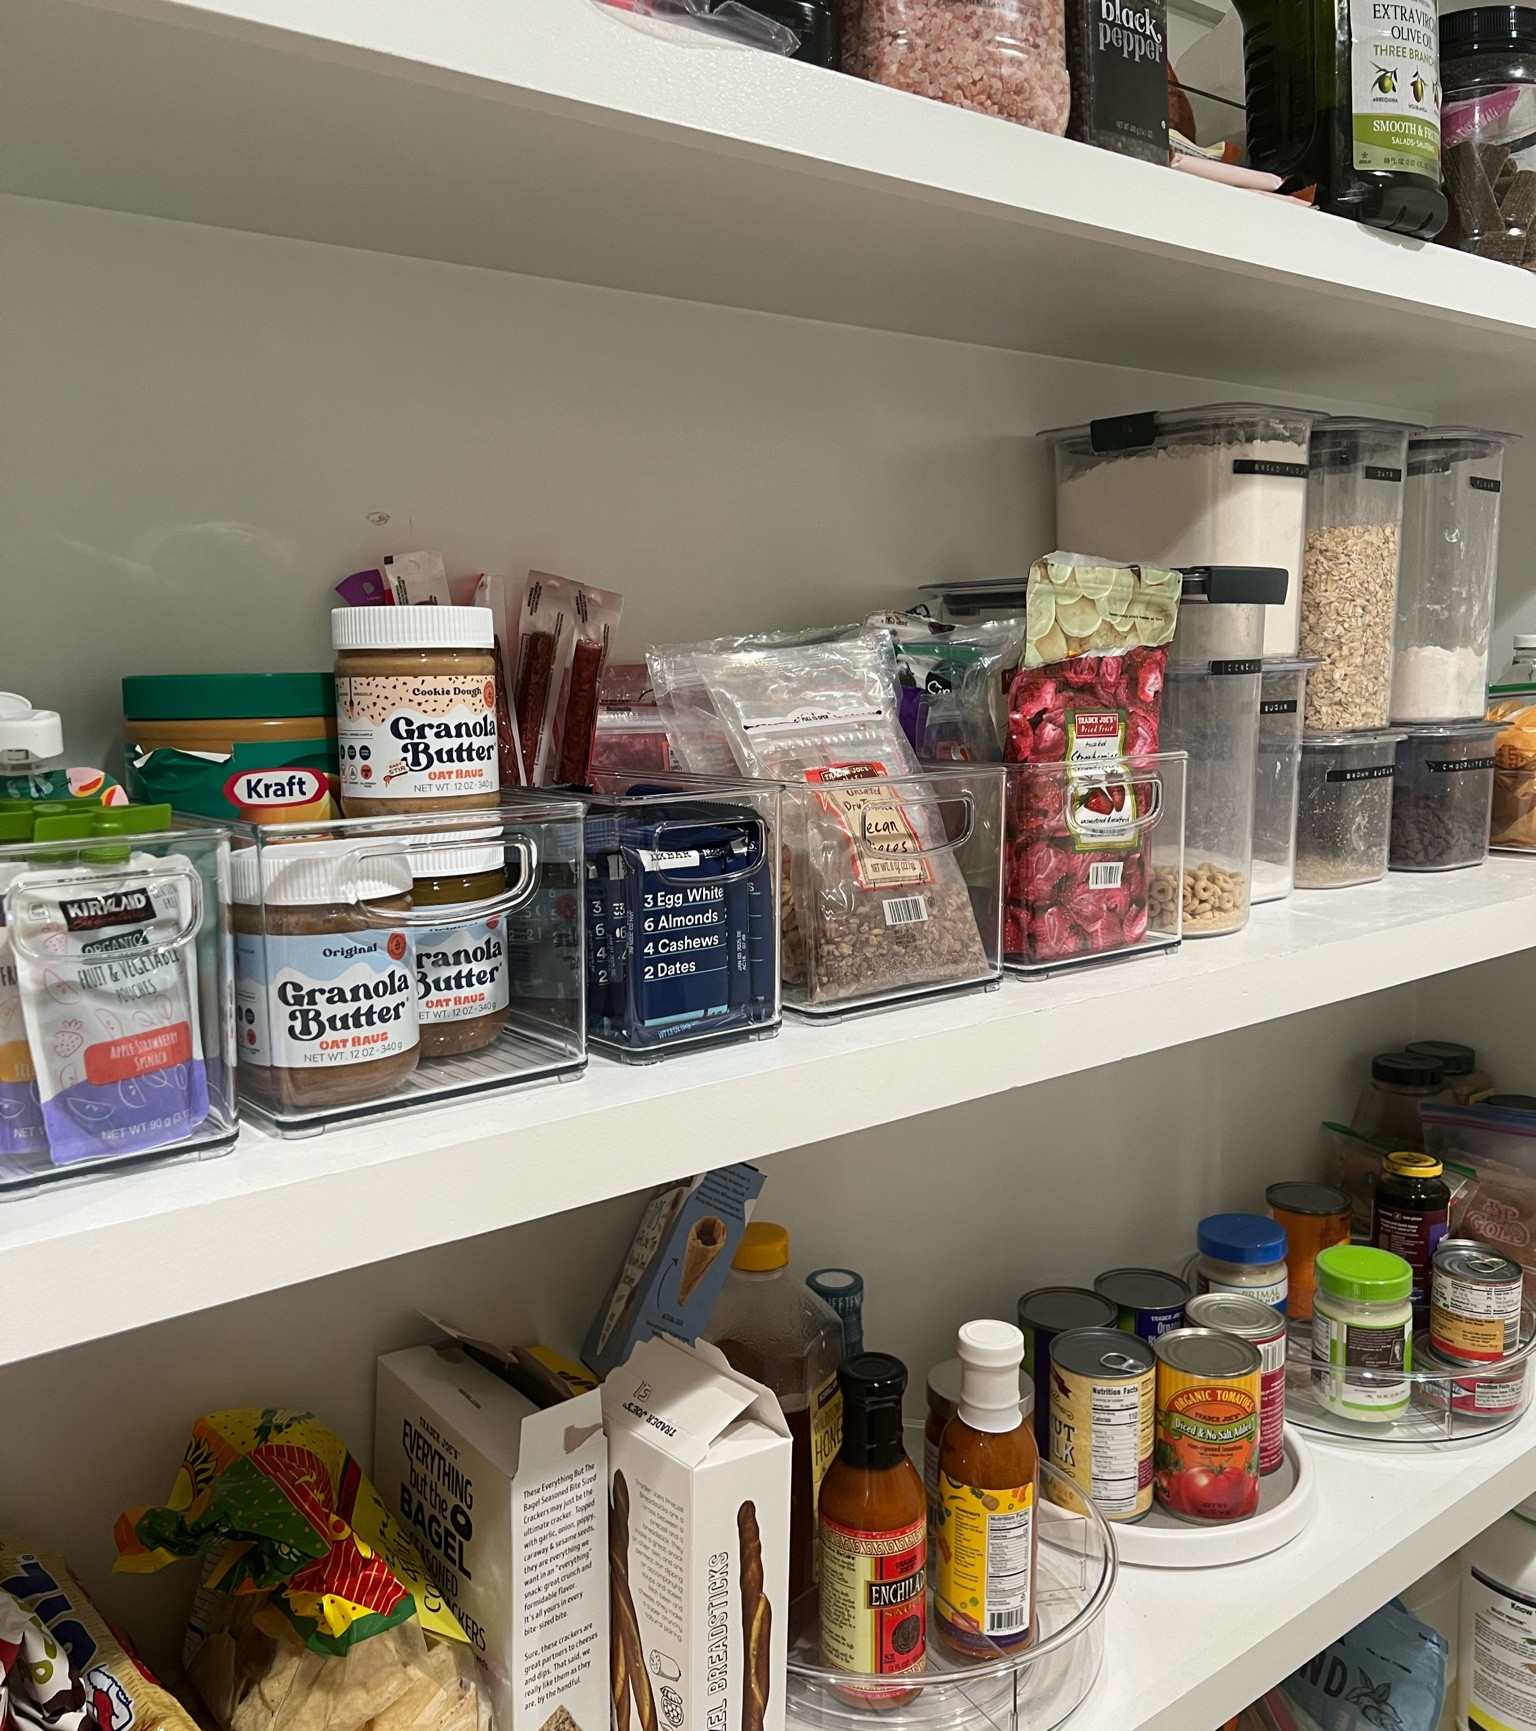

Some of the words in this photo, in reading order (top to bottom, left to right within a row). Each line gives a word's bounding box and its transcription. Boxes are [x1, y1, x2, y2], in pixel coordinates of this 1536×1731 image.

[1101, 0, 1162, 43] black
[1373, 4, 1415, 24] EXTRA
[1098, 22, 1163, 63] pepper
[1391, 25, 1422, 44] OLIVE
[1373, 44, 1407, 57] THREE
[1373, 120, 1416, 135] SMOOTH
[1417, 124, 1423, 136] &
[1254, 463, 1280, 473] BREAD
[412, 687, 451, 697] Cookie
[453, 686, 482, 699] Dough
[1264, 703, 1288, 712] SUGAR
[389, 715, 497, 741] Granola
[1078, 716, 1099, 724] TRADER
[1099, 716, 1115, 724] JOE'S
[1081, 724, 1098, 733] Dried
[1099, 724, 1114, 732] Fruit
[400, 741, 497, 773] Butter
[388, 765, 406, 775] STIR
[428, 769, 454, 781] OAT
[455, 768, 484, 780] HAUS
[1346, 771, 1369, 780] BROWN
[1373, 768, 1393, 777] SUGAR
[246, 775, 307, 800] Kraft
[414, 783, 432, 793] NET
[435, 782, 452, 792] WT.
[454, 782, 463, 791] 12
[463, 781, 474, 791] OZ
[866, 820, 899, 836] ecan
[593, 901, 602, 914] 3
[644, 894, 654, 908] 3
[657, 891, 683, 908] Egg
[595, 923, 605, 937] 6
[644, 918, 654, 931] 6
[657, 909, 719, 930] Almonds
[84, 933, 145, 954] ORGANIC
[322, 942, 378, 959] Original
[416, 936, 502, 970] ranola
[597, 947, 608, 959] 4
[643, 941, 655, 955] 4
[657, 932, 719, 953] Cashews
[78, 963, 108, 990] FRUIT
[108, 964, 120, 981] &
[120, 948, 180, 979] VEGETABLE
[599, 970, 609, 983] 2
[643, 966, 654, 979] 2
[657, 960, 696, 978] Dates
[115, 978, 157, 1004] POUCHES
[277, 969, 410, 1007] Granola
[425, 998, 452, 1009] OAT
[453, 992, 486, 1007] HAUS
[288, 997, 410, 1042] Butter
[432, 1008, 450, 1019] WT.
[452, 1007, 460, 1016] 12
[462, 1006, 473, 1015] OZ
[319, 1036, 351, 1051] OAT
[351, 1031, 389, 1048] HAUS
[304, 1053, 325, 1063] NET
[327, 1051, 348, 1062] WT.
[350, 1049, 360, 1059] 12
[362, 1047, 375, 1058] OZ
[14, 1128, 36, 1138] NET
[102, 1127, 126, 1140] NET
[129, 1121, 147, 1136] WT
[150, 1117, 162, 1130] 90
[164, 1117, 172, 1128] g
[1242, 1287, 1279, 1300] PRIMAL
[1151, 1314, 1172, 1322] TRADER
[1092, 1386, 1121, 1396] Nutrition
[1123, 1386, 1138, 1395] Facts
[1173, 1390, 1212, 1411] ORGANIC
[1216, 1389, 1254, 1412] TOMATOES
[623, 1402, 648, 1418] JOE'S
[1194, 1412, 1220, 1422] TRADER
[646, 1414, 677, 1437] TRADER
[1052, 1415, 1075, 1442] UT
[1175, 1418, 1196, 1434] Diced
[1197, 1427, 1206, 1437] &
[1206, 1429, 1217, 1440] No
[1218, 1427, 1232, 1440] Salt
[1233, 1421, 1252, 1437] Added
[419, 1416, 441, 1442] TRADER
[441, 1440, 460, 1460] JOE'S
[403, 1418, 473, 1510] EVERYTHING
[410, 1463, 428, 1501] but
[429, 1481, 448, 1520] the
[524, 1487, 540, 1499] These
[541, 1473, 573, 1491] Everything
[524, 1498, 541, 1512] Bagel
[541, 1487, 569, 1505] Seasoned
[570, 1482, 580, 1492] Bite
[581, 1473, 597, 1487] Sized
[524, 1508, 549, 1524] Crackers
[563, 1496, 575, 1509] just
[524, 1520, 549, 1537] ultimate
[575, 1499, 595, 1514] Topped
[400, 1482, 472, 1581] BAGEL
[524, 1538, 538, 1549] with
[524, 1547, 548, 1562] caraway
[555, 1534, 577, 1548] sesame
[410, 1530, 459, 1598] SEASONED
[524, 1564, 538, 1574] they
[549, 1543, 581, 1563] everything
[524, 1575, 539, 1587] want
[543, 1578, 560, 1593] great
[560, 1568, 581, 1582] crunch
[524, 1592, 557, 1611] formidable
[543, 1603, 561, 1617] yours
[567, 1591, 583, 1603] every
[1510, 1601, 1533, 1617] Know
[524, 1616, 555, 1636] bite-sized
[706, 1551, 730, 1696] BREADSTICKS
[541, 1640, 558, 1653] these
[558, 1627, 583, 1644] crackers
[524, 1660, 541, 1675] great
[541, 1648, 568, 1667] partners
[575, 1632, 598, 1648] cheeses
[553, 1660, 567, 1671] That
[524, 1683, 541, 1698] really
[542, 1677, 553, 1689] like
[554, 1669, 570, 1683] them
[577, 1660, 591, 1672] they
